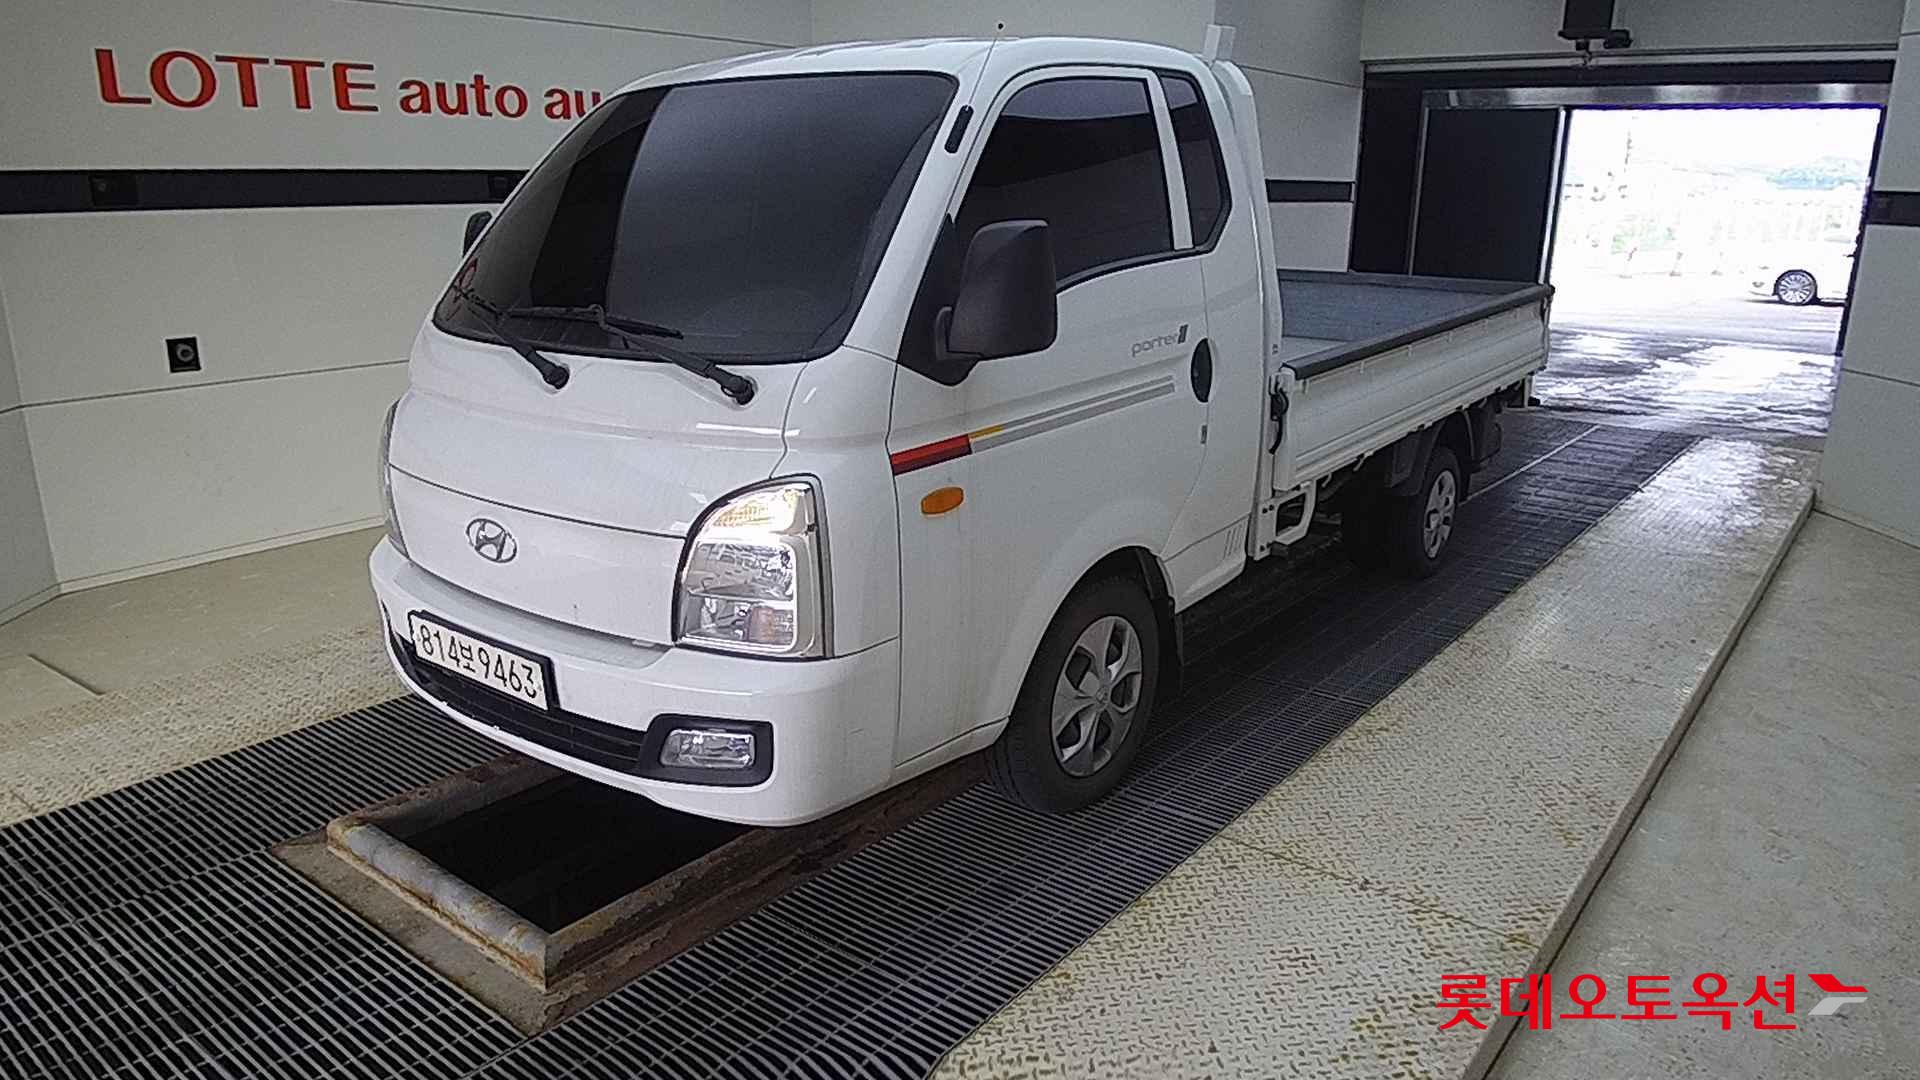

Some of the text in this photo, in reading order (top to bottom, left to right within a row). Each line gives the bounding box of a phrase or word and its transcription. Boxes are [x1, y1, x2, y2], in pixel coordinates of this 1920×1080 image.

[95, 48, 379, 112] LOTTE
[399, 74, 528, 118] auto
[420, 624, 537, 699] 814보9463
